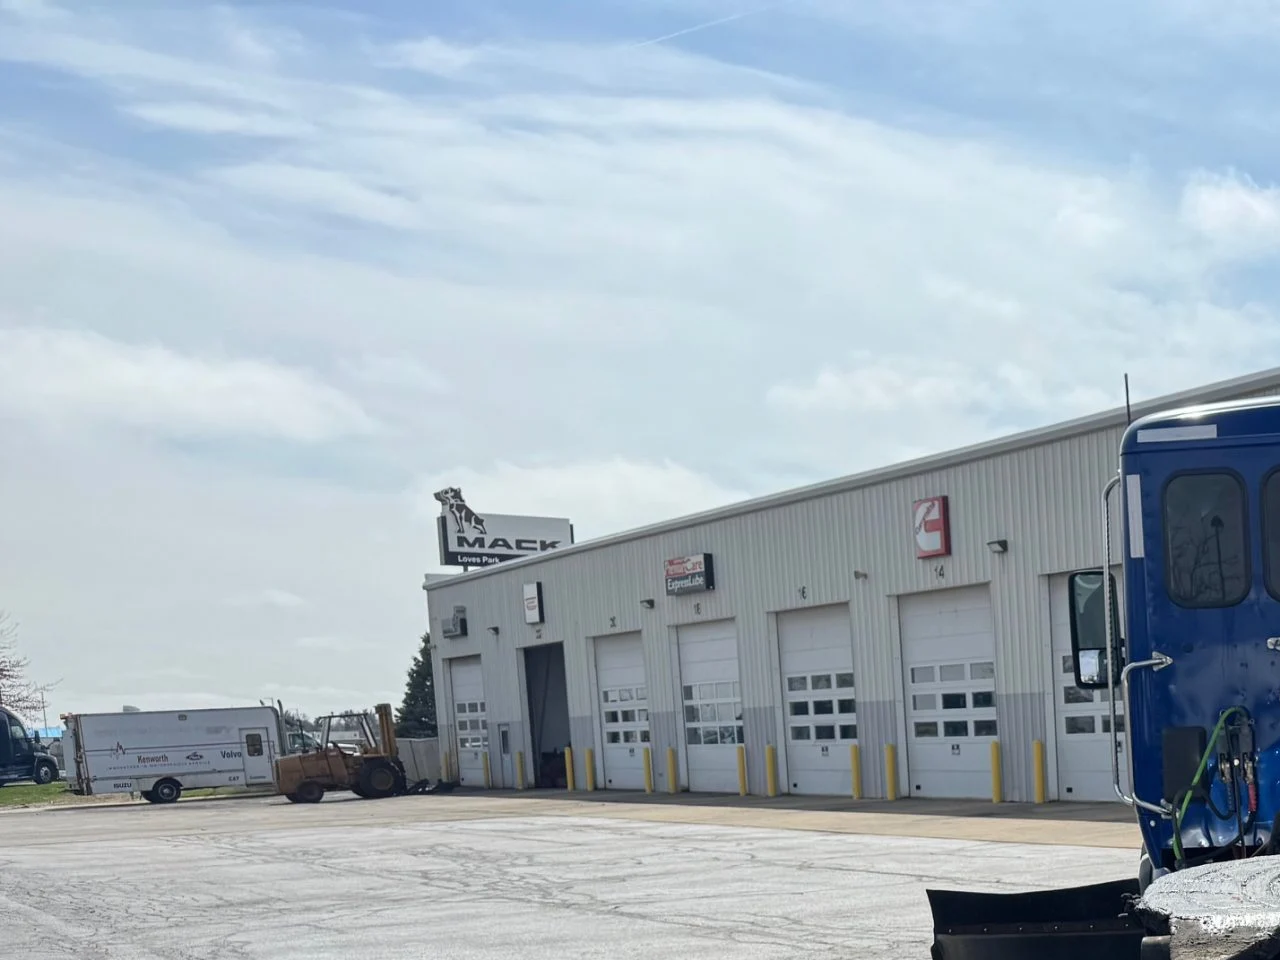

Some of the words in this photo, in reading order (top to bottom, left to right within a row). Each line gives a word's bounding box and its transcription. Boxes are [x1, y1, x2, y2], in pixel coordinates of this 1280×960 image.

[456, 535, 561, 552] MACK
[458, 555, 481, 563] Loves
[482, 556, 500, 564] Park
[137, 753, 169, 764] Kenworth
[220, 750, 242, 760] Volvo
